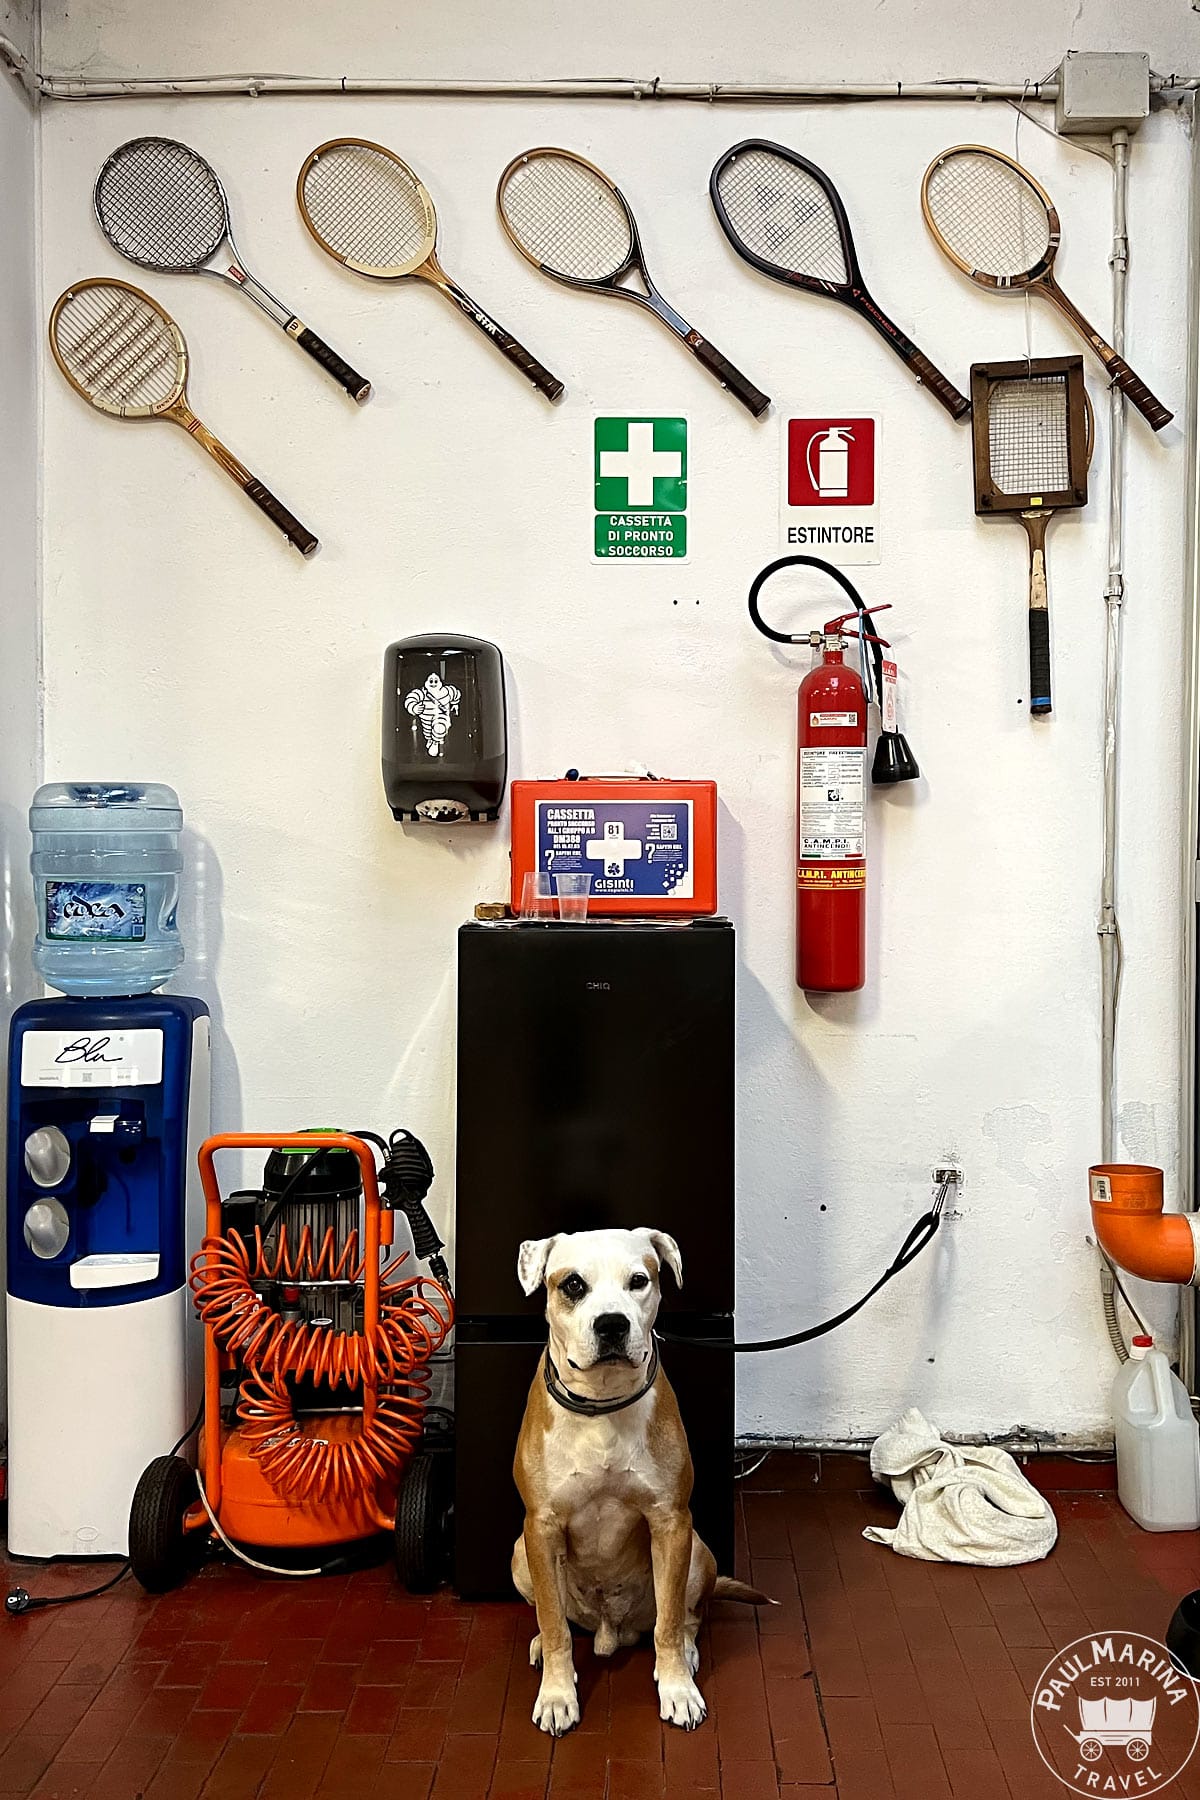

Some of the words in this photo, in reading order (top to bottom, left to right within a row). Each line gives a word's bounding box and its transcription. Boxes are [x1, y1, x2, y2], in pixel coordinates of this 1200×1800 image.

[860, 297, 897, 336] FISCHER
[610, 516, 672, 526] CASSETTA
[608, 531, 620, 541] DI
[624, 531, 674, 541] PRONTO
[788, 526, 874, 544] ESTINTORE
[608, 546, 673, 556] SOCCORSO
[547, 808, 595, 820] CASSETTA
[608, 824, 619, 835] 81
